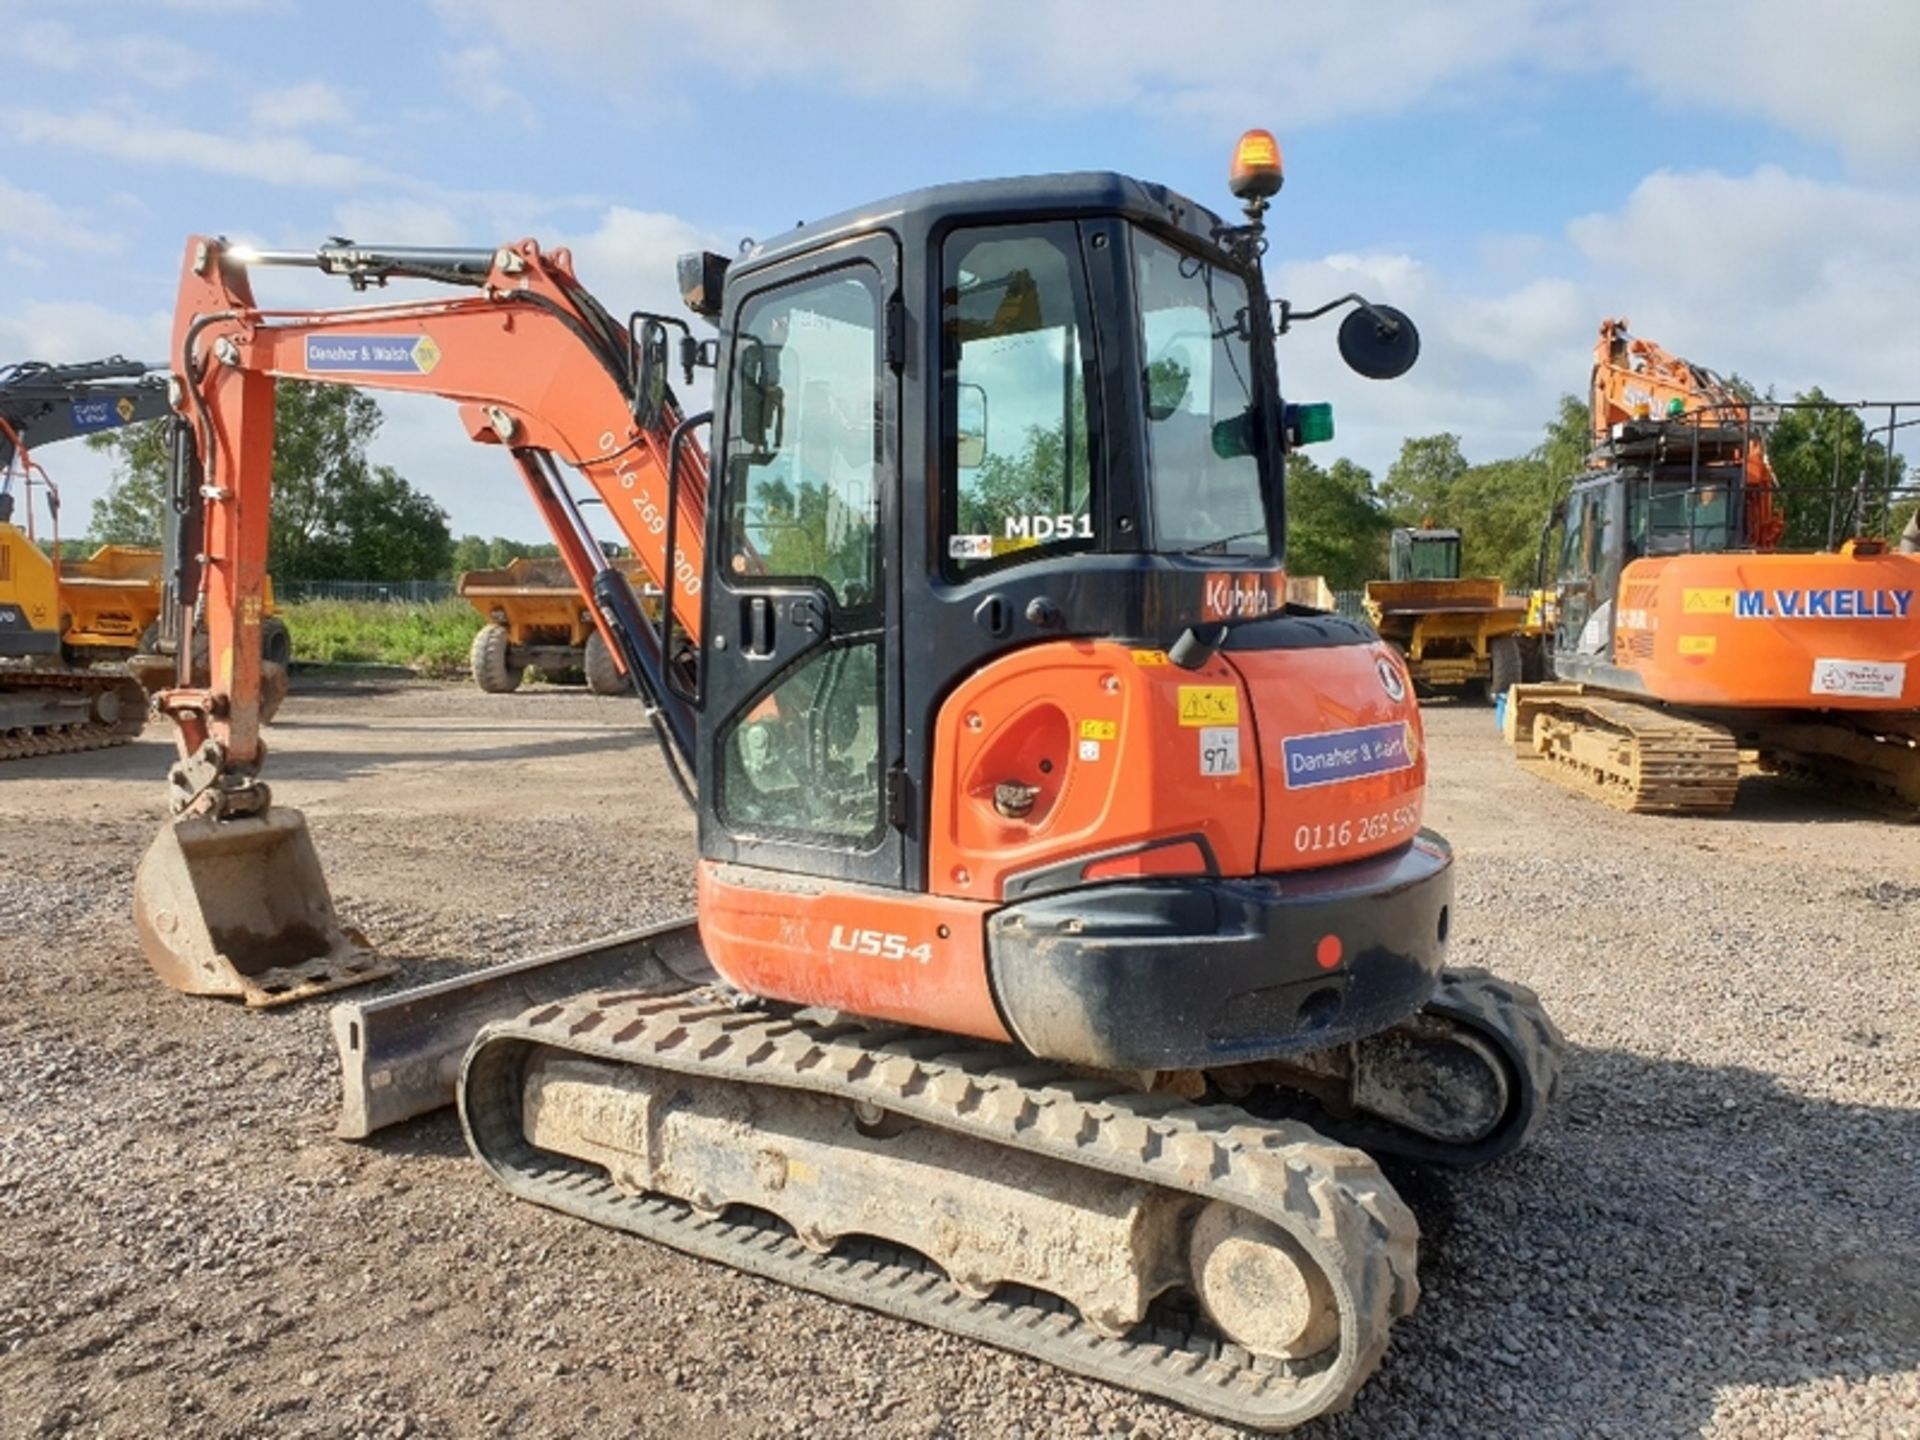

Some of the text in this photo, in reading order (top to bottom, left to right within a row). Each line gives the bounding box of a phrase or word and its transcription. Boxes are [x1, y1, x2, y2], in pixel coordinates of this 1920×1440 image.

[632, 488, 666, 535] 269
[660, 543, 702, 597] 900
[1004, 513, 1095, 540] MD51
[1206, 578, 1268, 617] Kubota
[1292, 746, 1357, 773] Danaher
[1294, 820, 1352, 852] 0116
[1357, 812, 1389, 843] 269
